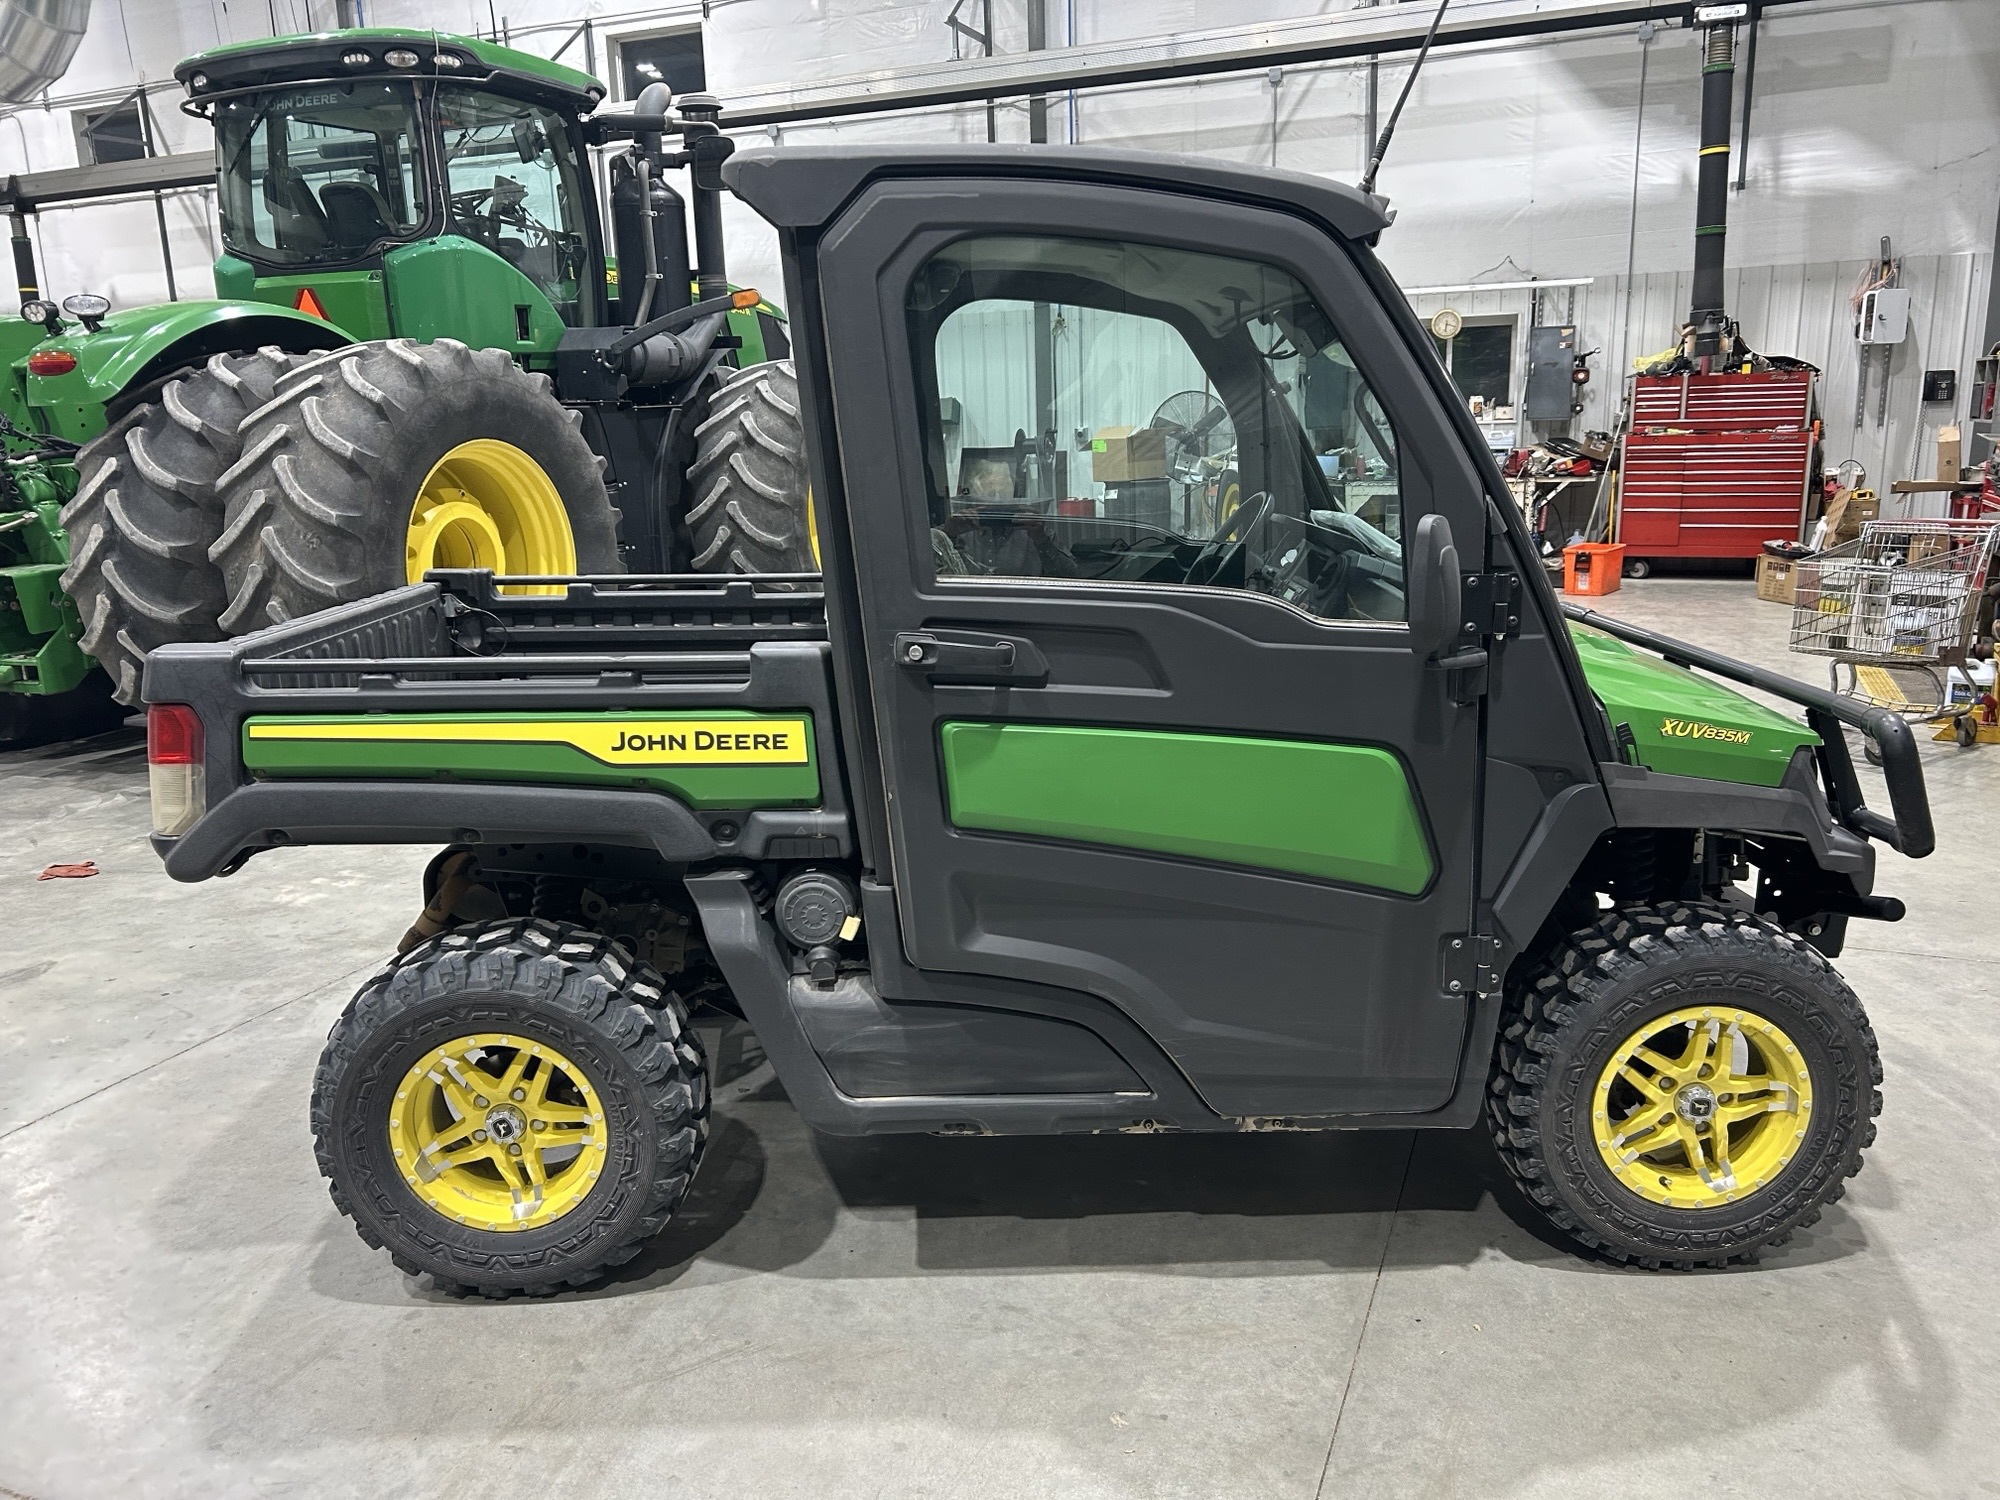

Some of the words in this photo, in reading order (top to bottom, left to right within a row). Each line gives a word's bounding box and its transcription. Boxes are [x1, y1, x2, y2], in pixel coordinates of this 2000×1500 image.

[295, 93, 338, 108] DEERE
[611, 731, 686, 752] JOHN
[694, 730, 789, 751] DEERE
[1661, 718, 1751, 744] XUV835M
